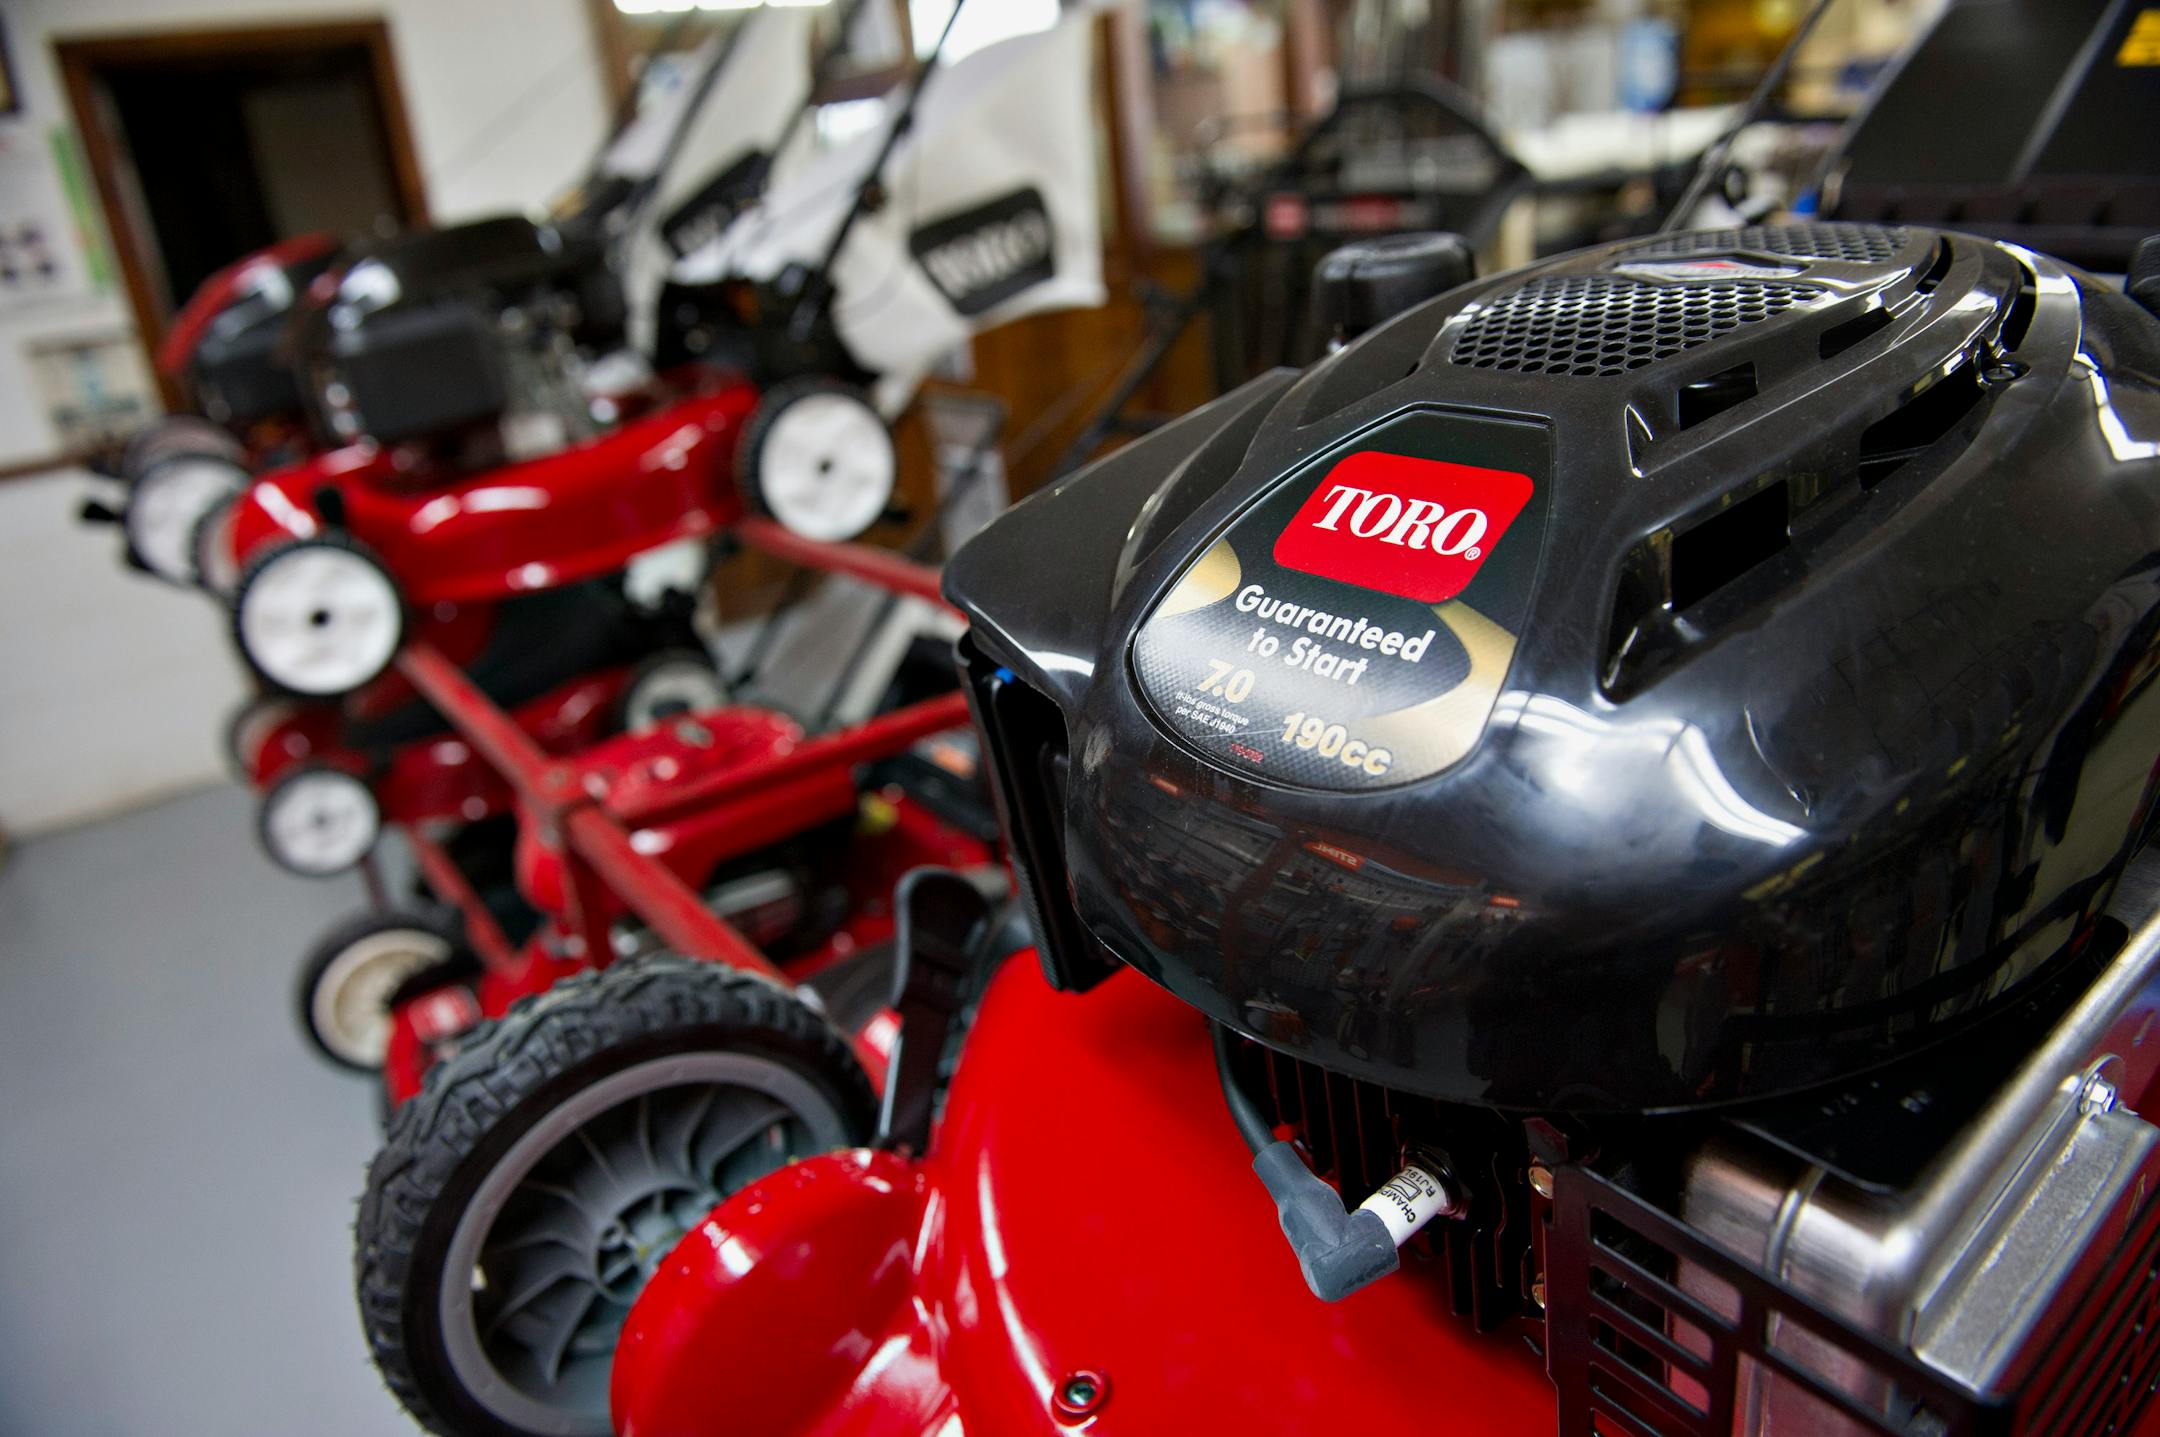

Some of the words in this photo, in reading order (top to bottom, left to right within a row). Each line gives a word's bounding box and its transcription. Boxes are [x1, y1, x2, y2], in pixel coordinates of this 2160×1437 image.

[1235, 584, 1436, 663] Guaranteed
[1197, 659, 1256, 704] 7.0
[1247, 627, 1280, 658] to
[1283, 636, 1369, 686] Start
[1175, 706, 1191, 718] per
[1191, 710, 1210, 725] SAE
[1209, 718, 1236, 734] J1940
[1196, 700, 1221, 716] gross
[1221, 709, 1250, 726] torque
[1280, 712, 1393, 776] 190cc
